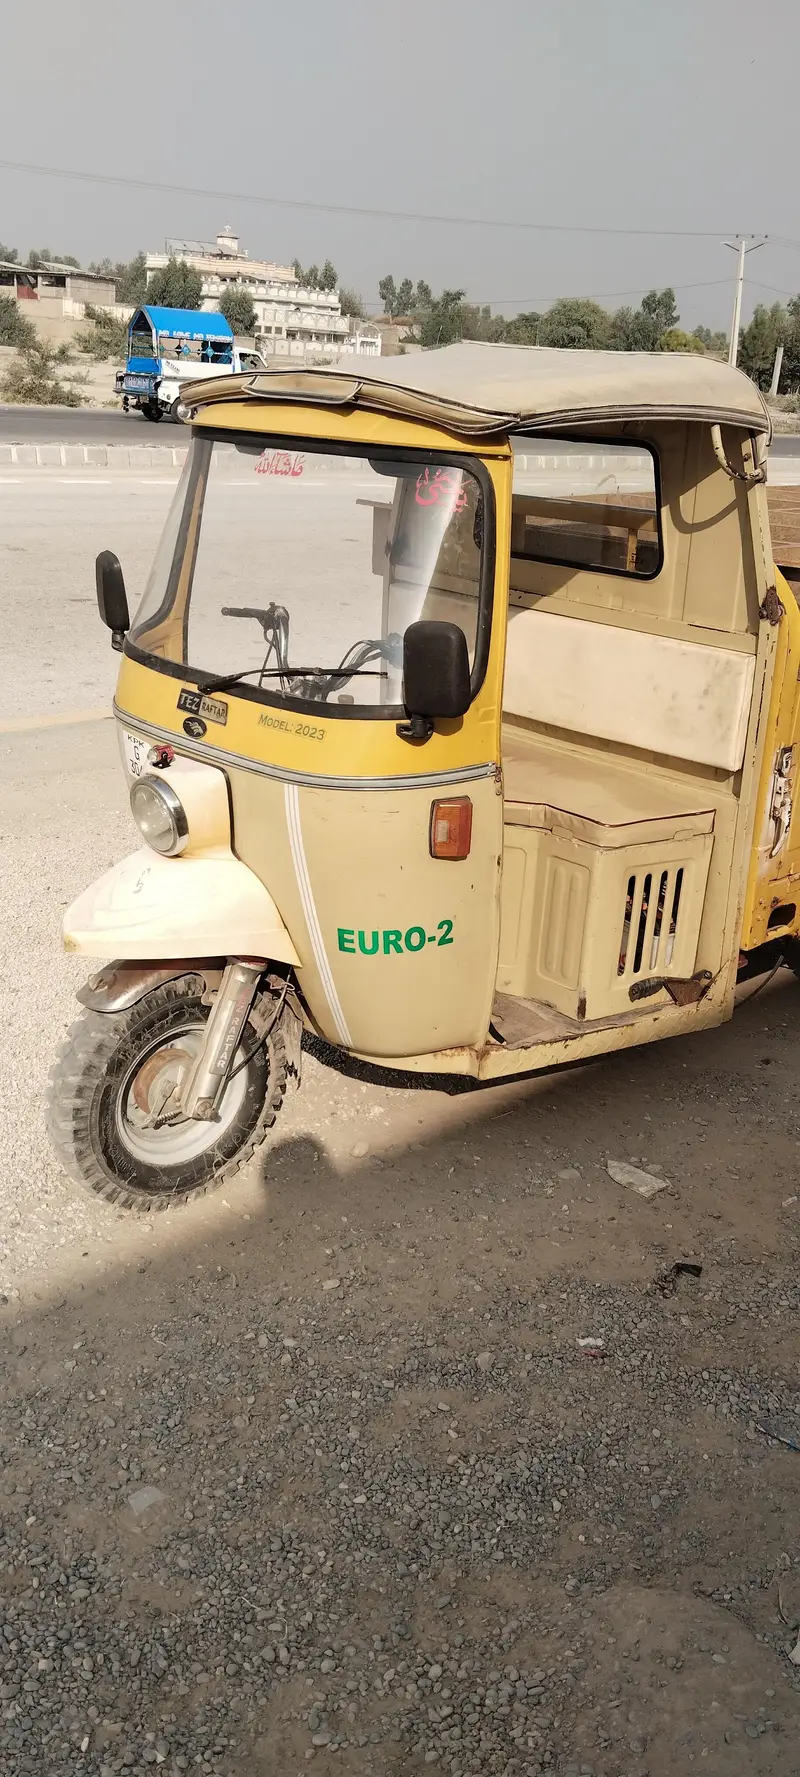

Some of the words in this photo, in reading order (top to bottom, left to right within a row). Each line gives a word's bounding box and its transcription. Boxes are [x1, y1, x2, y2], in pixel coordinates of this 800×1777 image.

[179, 692, 200, 711] TEZ
[200, 700, 227, 719] RAFTAR
[127, 734, 145, 748] KPK
[294, 723, 326, 741] 2023
[337, 919, 454, 955] EURO-2
[216, 1017, 240, 1068] RAFTAR
